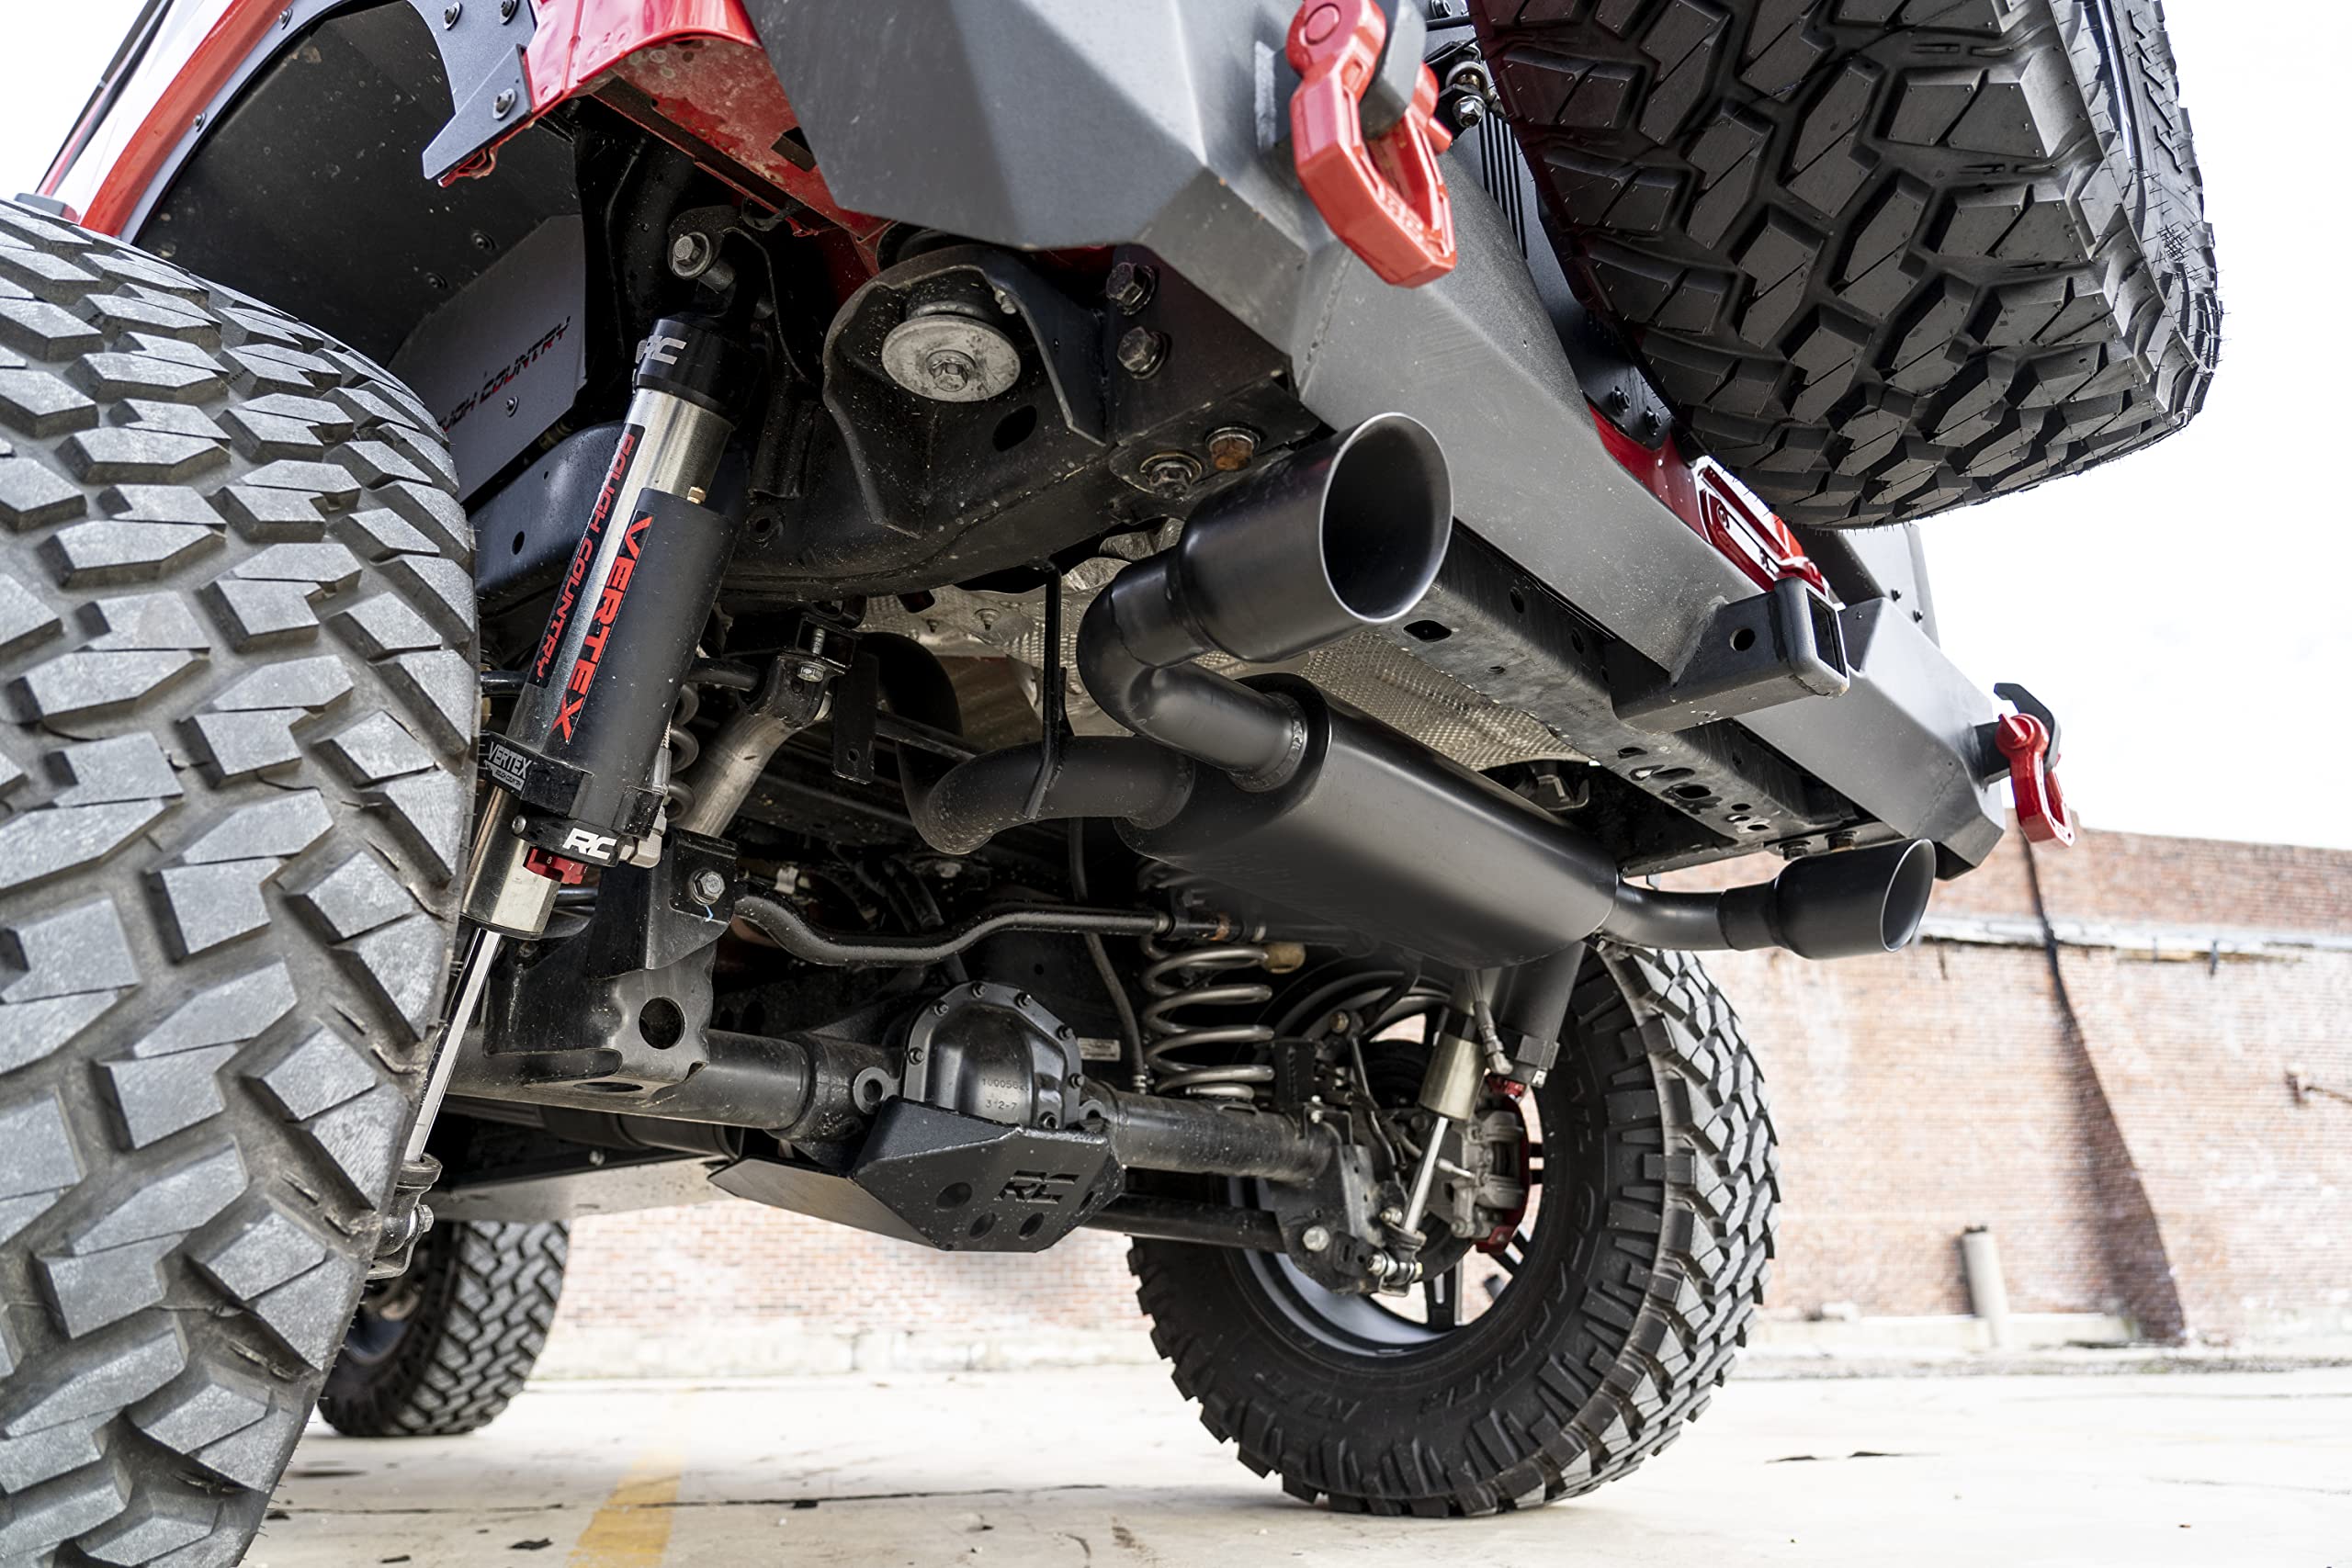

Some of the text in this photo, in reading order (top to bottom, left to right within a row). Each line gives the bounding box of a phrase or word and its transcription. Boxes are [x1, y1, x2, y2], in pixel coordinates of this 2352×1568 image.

[480, 316, 571, 404] COUNTRY
[537, 433, 636, 678] ROUGH COUNTRY
[549, 515, 654, 742] VERTEX
[488, 741, 533, 779] VERTEX
[562, 828, 617, 860] RC
[993, 1169, 1080, 1204] RC
